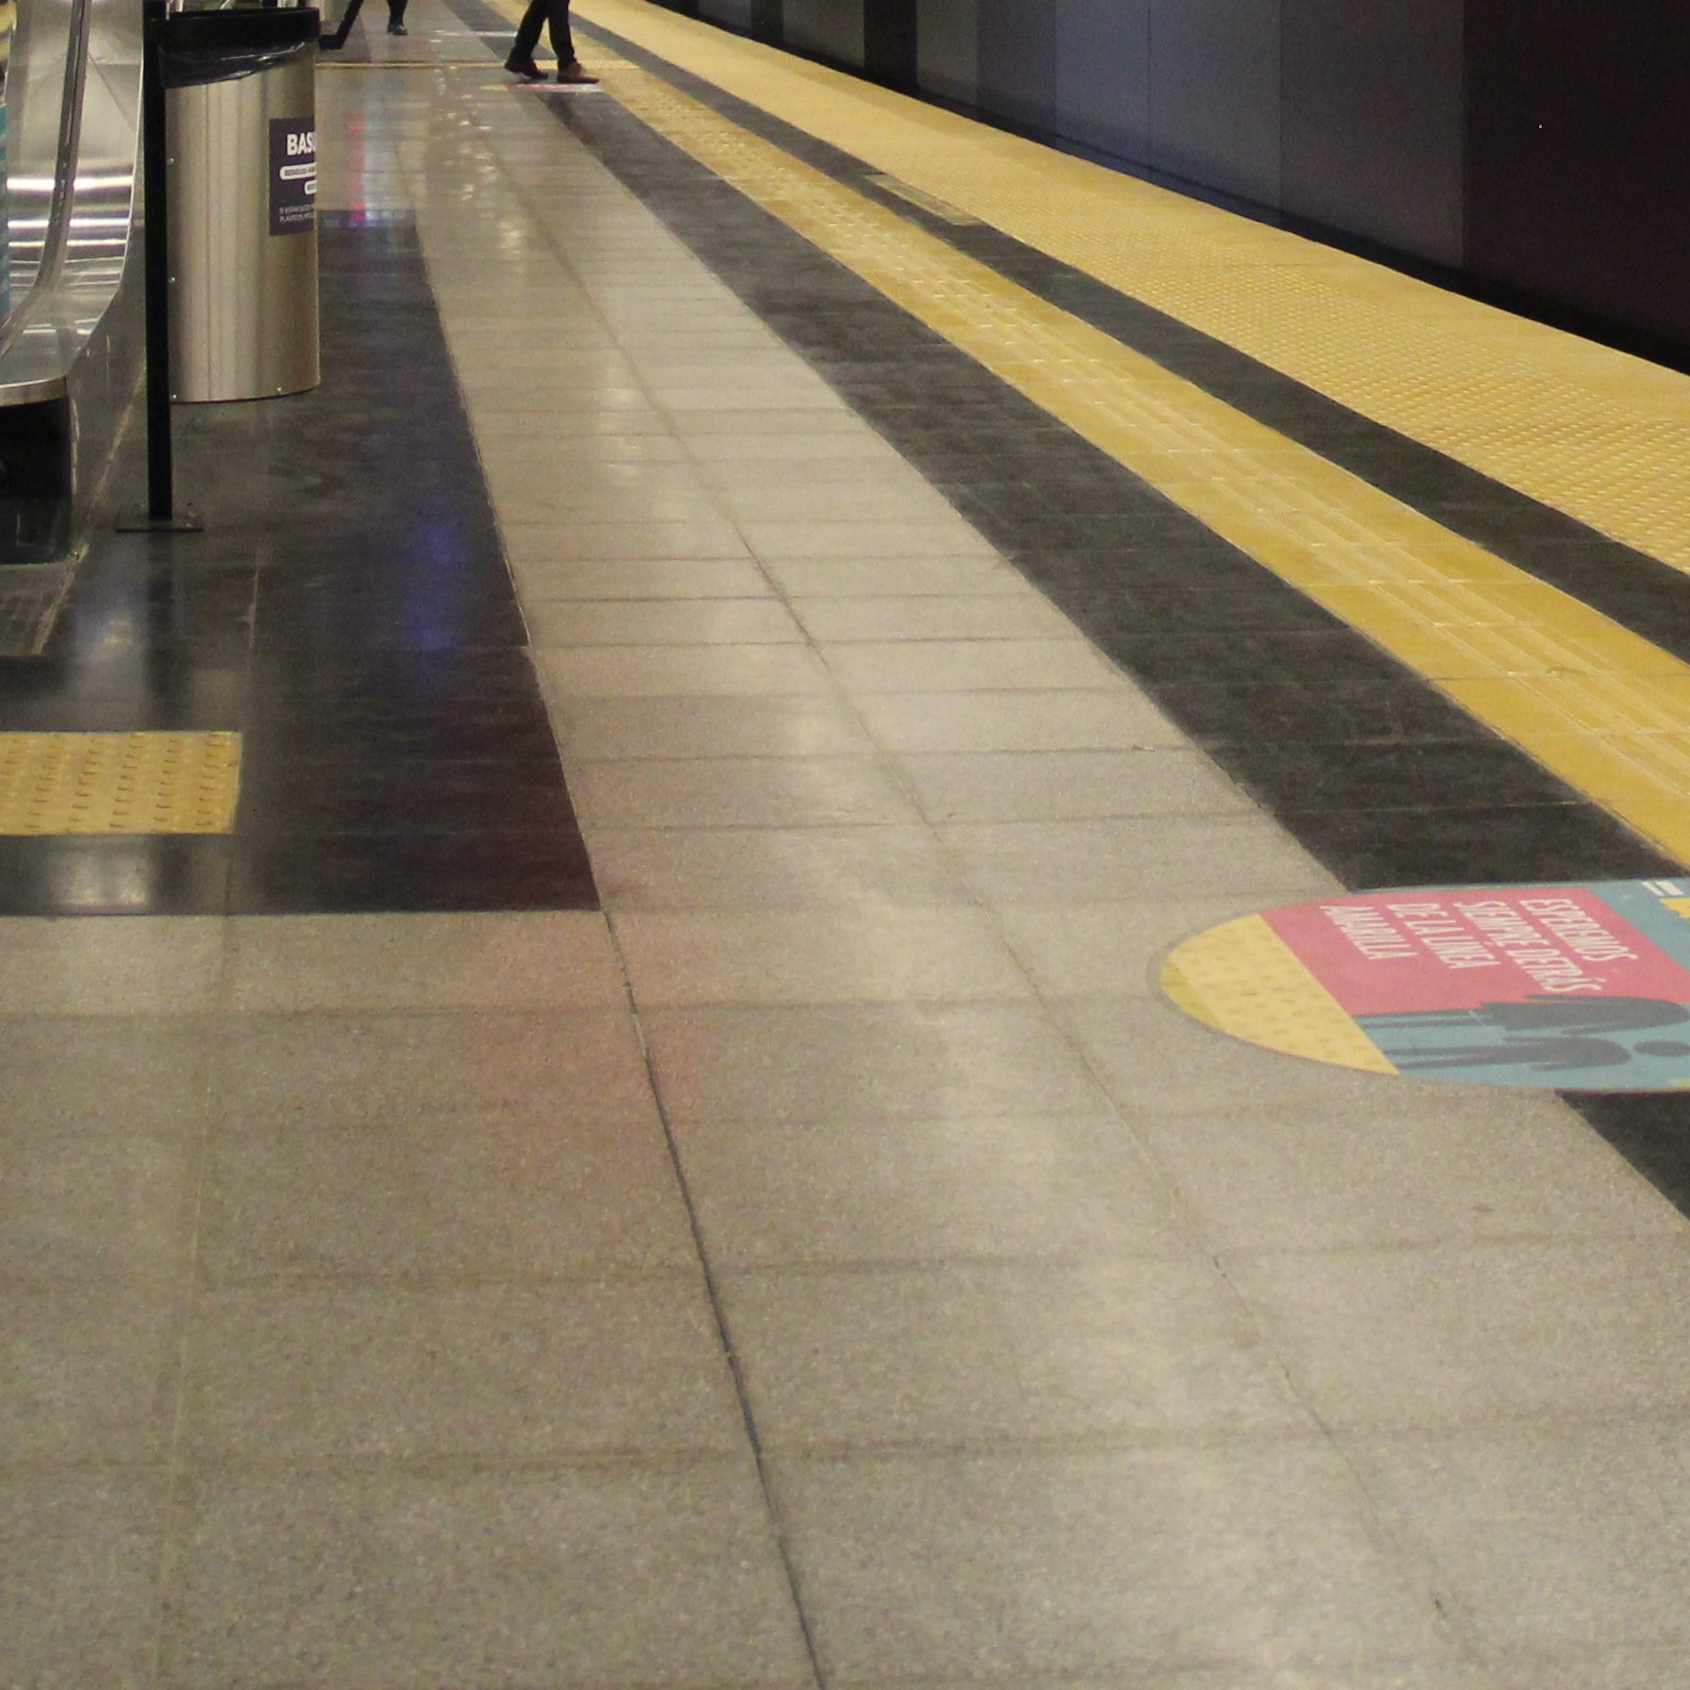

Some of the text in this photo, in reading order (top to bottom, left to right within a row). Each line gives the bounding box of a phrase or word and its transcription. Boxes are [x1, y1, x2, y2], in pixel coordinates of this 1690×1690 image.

[1319, 905, 1419, 960] AMARILLA
[1386, 902, 1449, 919] DE
[1403, 919, 1465, 934] LA
[1519, 898, 1638, 961] ESPEREMOS
[1453, 899, 1607, 992] SIEMPRE DETRÁS
